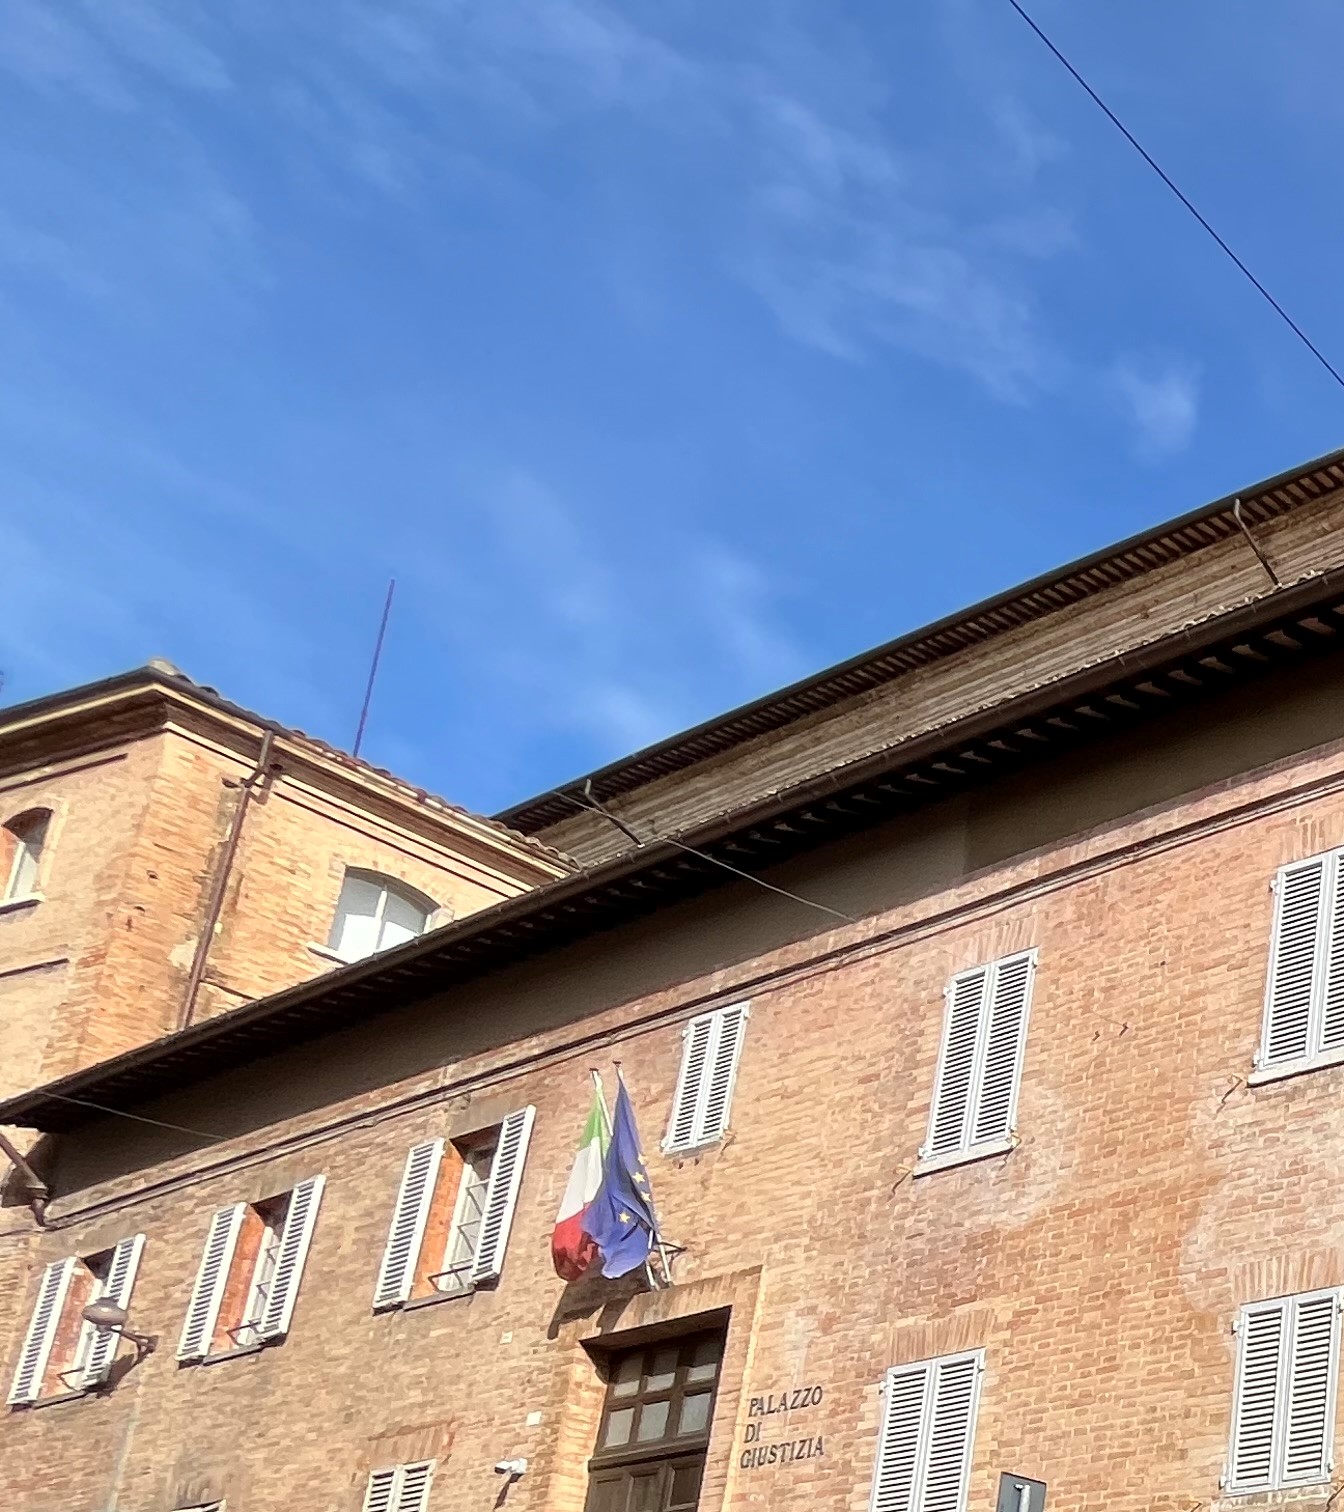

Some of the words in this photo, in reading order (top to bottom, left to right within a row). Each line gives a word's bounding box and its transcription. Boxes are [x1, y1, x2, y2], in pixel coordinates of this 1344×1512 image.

[748, 1386, 823, 1418] PALAZZO
[743, 1421, 763, 1444] DI
[740, 1435, 824, 1469] GIUSTIZIA
